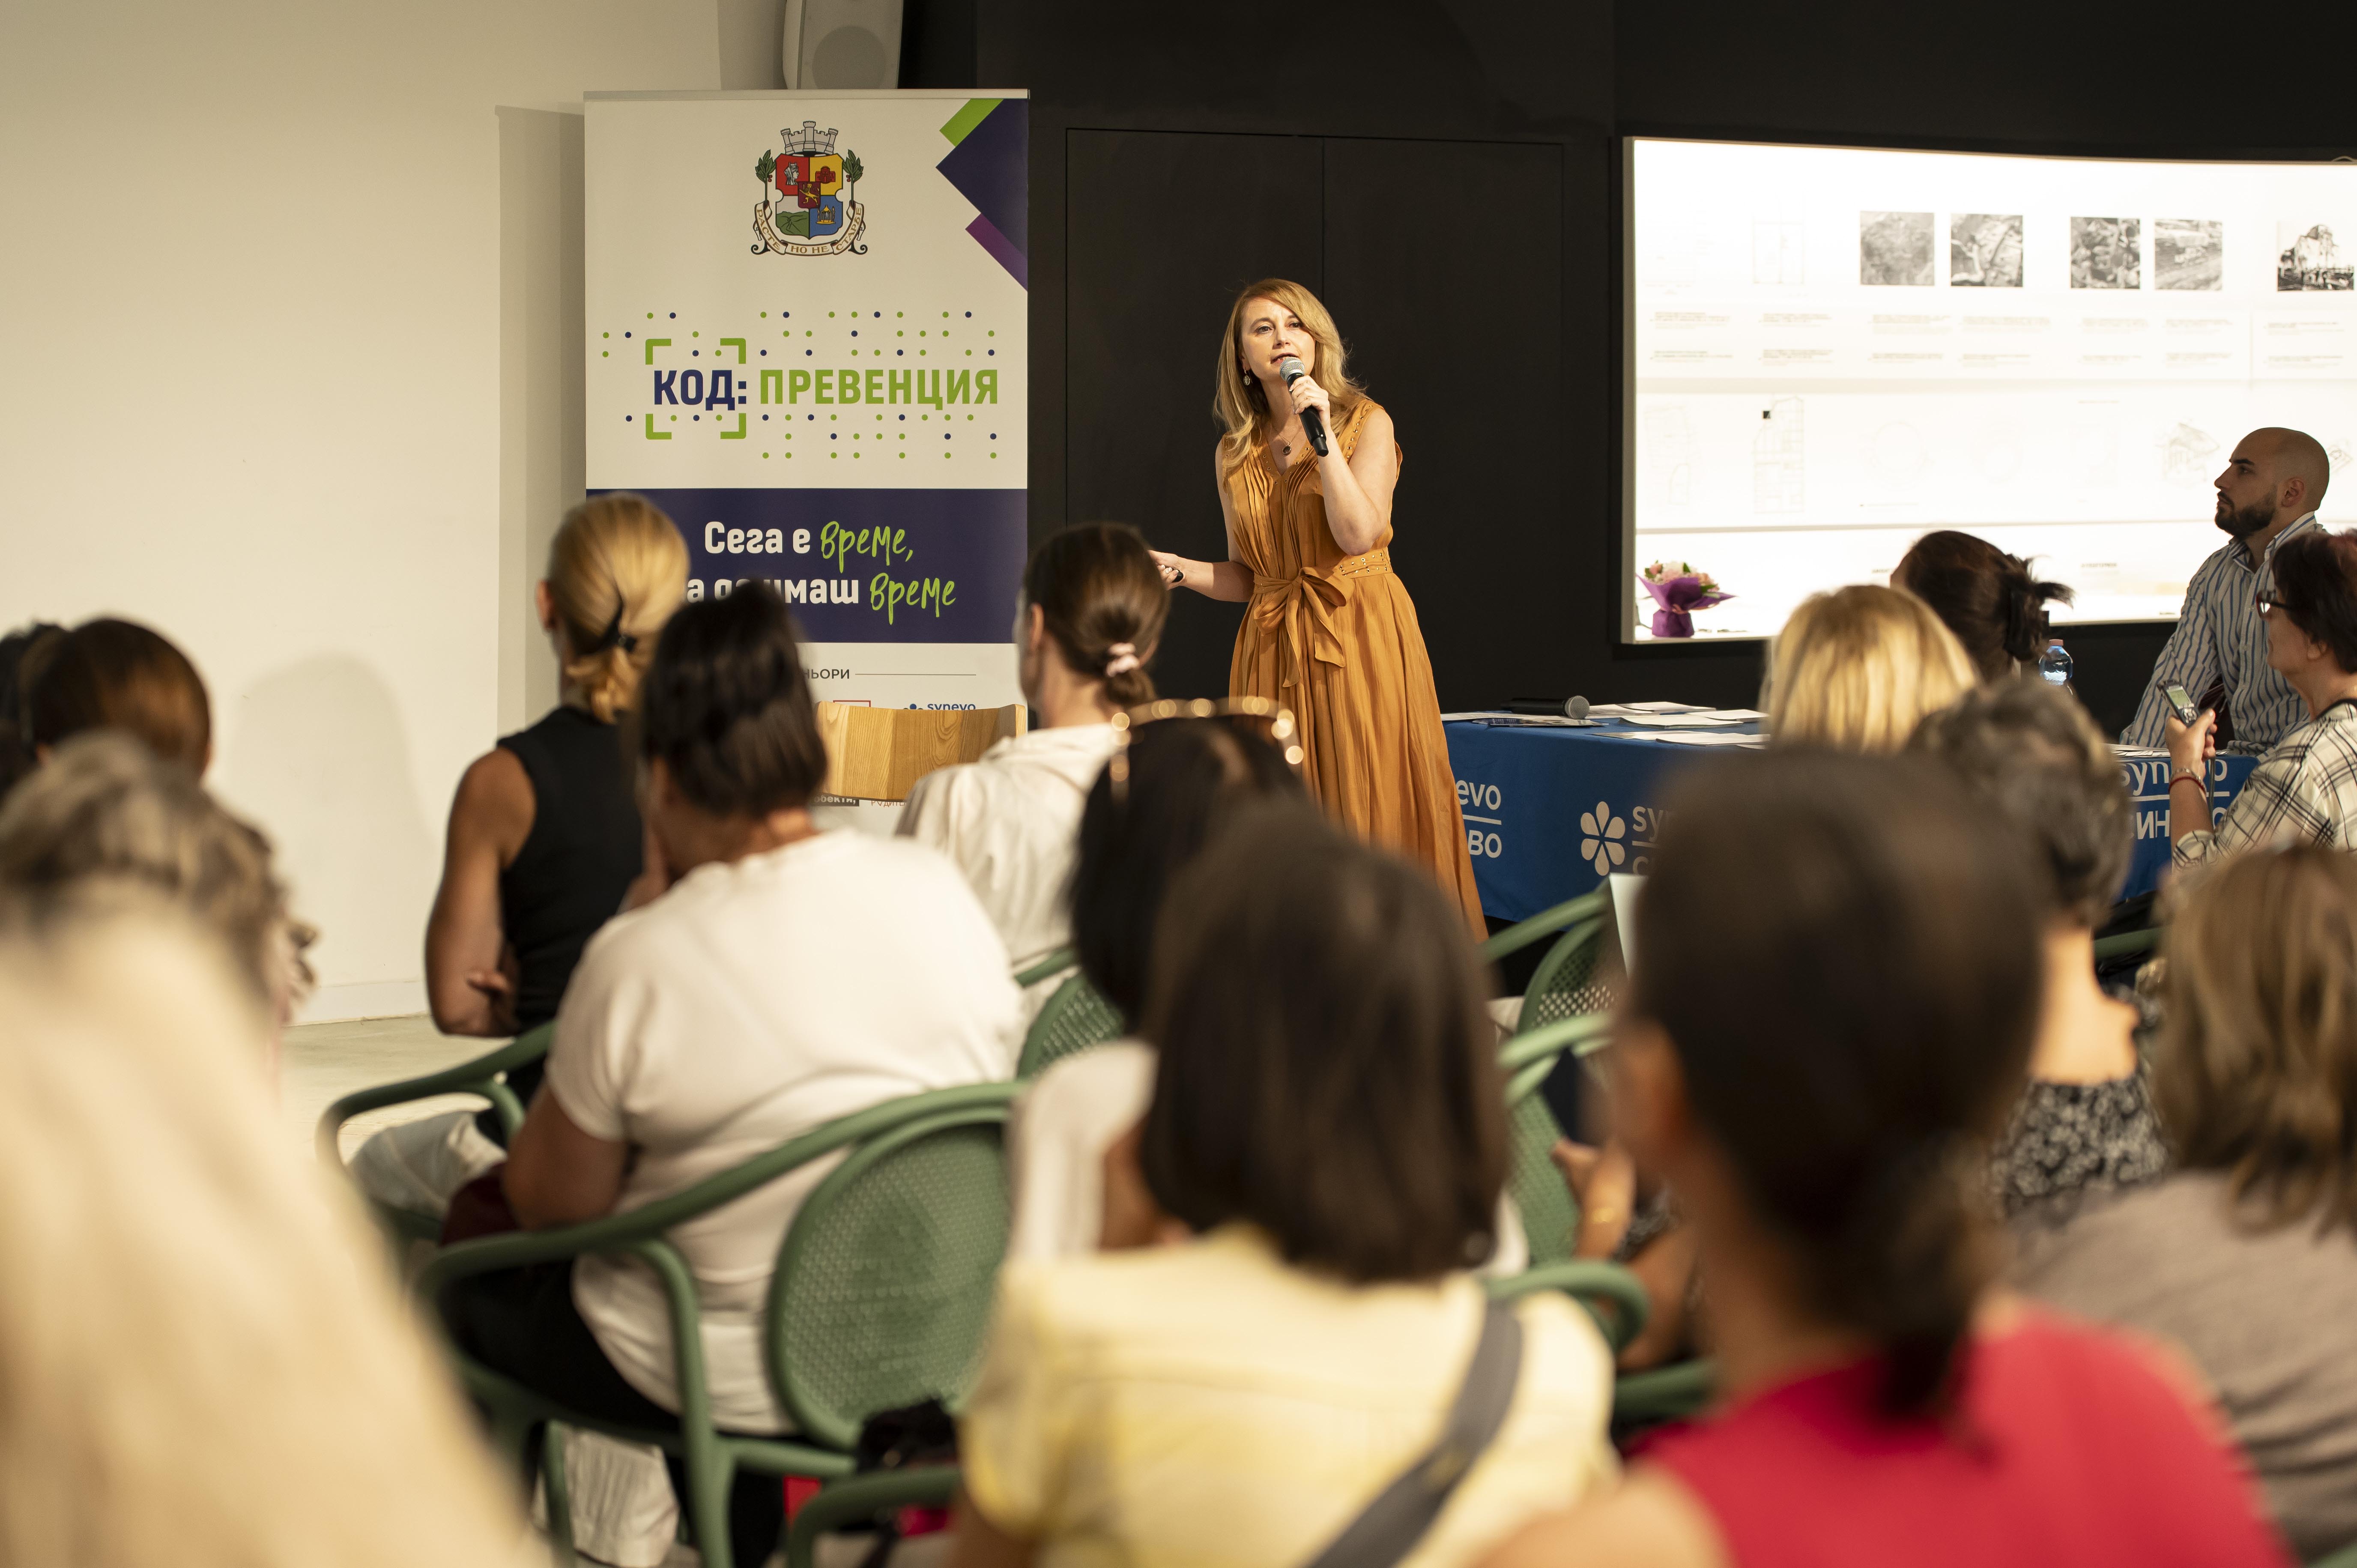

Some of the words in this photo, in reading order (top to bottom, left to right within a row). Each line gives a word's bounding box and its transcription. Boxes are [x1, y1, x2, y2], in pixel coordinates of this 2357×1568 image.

[757, 209, 780, 250] РАСТЕ
[791, 245, 807, 254] НО
[812, 245, 829, 254] НЕ
[654, 369, 747, 410] КОД:
[760, 369, 998, 410] ПРЕВЕНЦИЯ
[705, 521, 783, 554] Сега
[793, 529, 810, 554] е
[687, 579, 704, 603] а
[804, 669, 849, 679] НЬОРИ
[1455, 780, 1501, 810] evo
